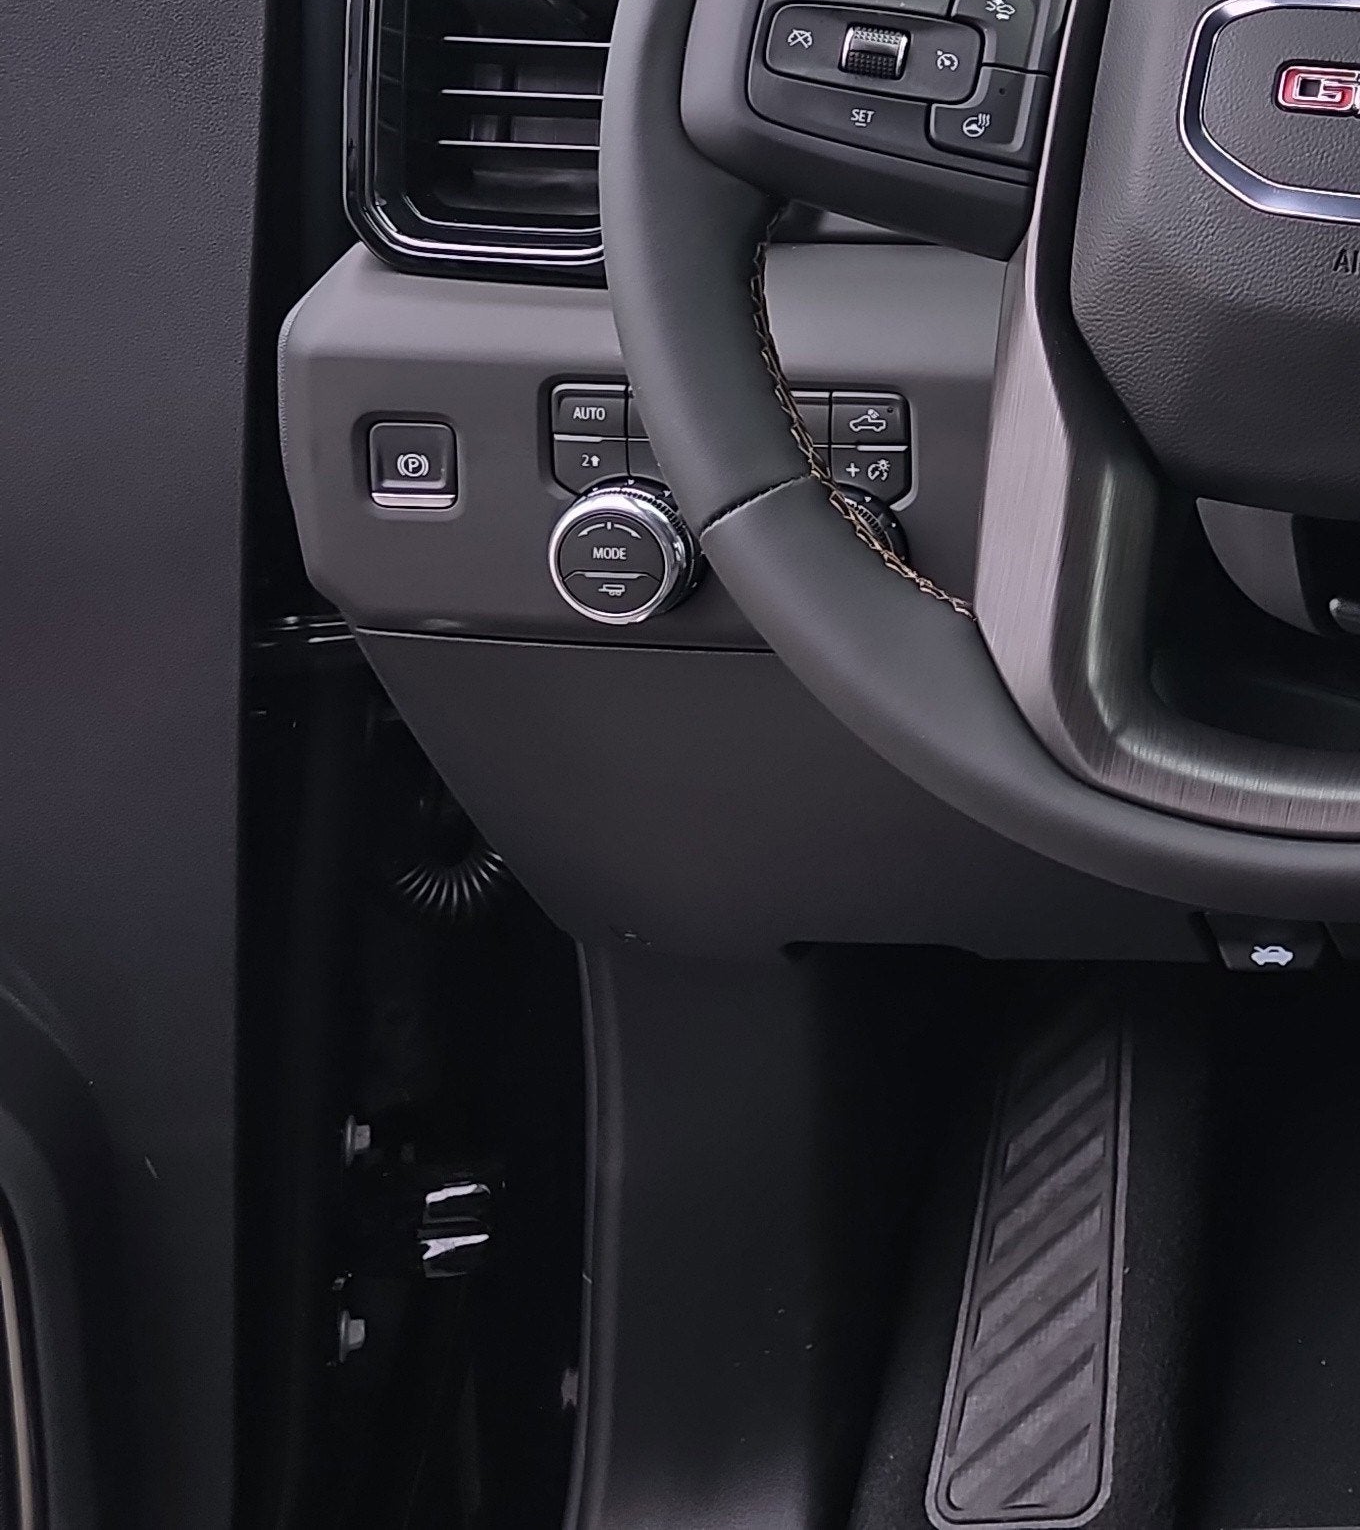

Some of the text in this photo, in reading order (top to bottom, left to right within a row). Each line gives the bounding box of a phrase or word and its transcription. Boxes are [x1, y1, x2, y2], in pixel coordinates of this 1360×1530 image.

[850, 108, 875, 123] SET
[572, 406, 606, 421] AUTO
[592, 547, 628, 561] MODE
